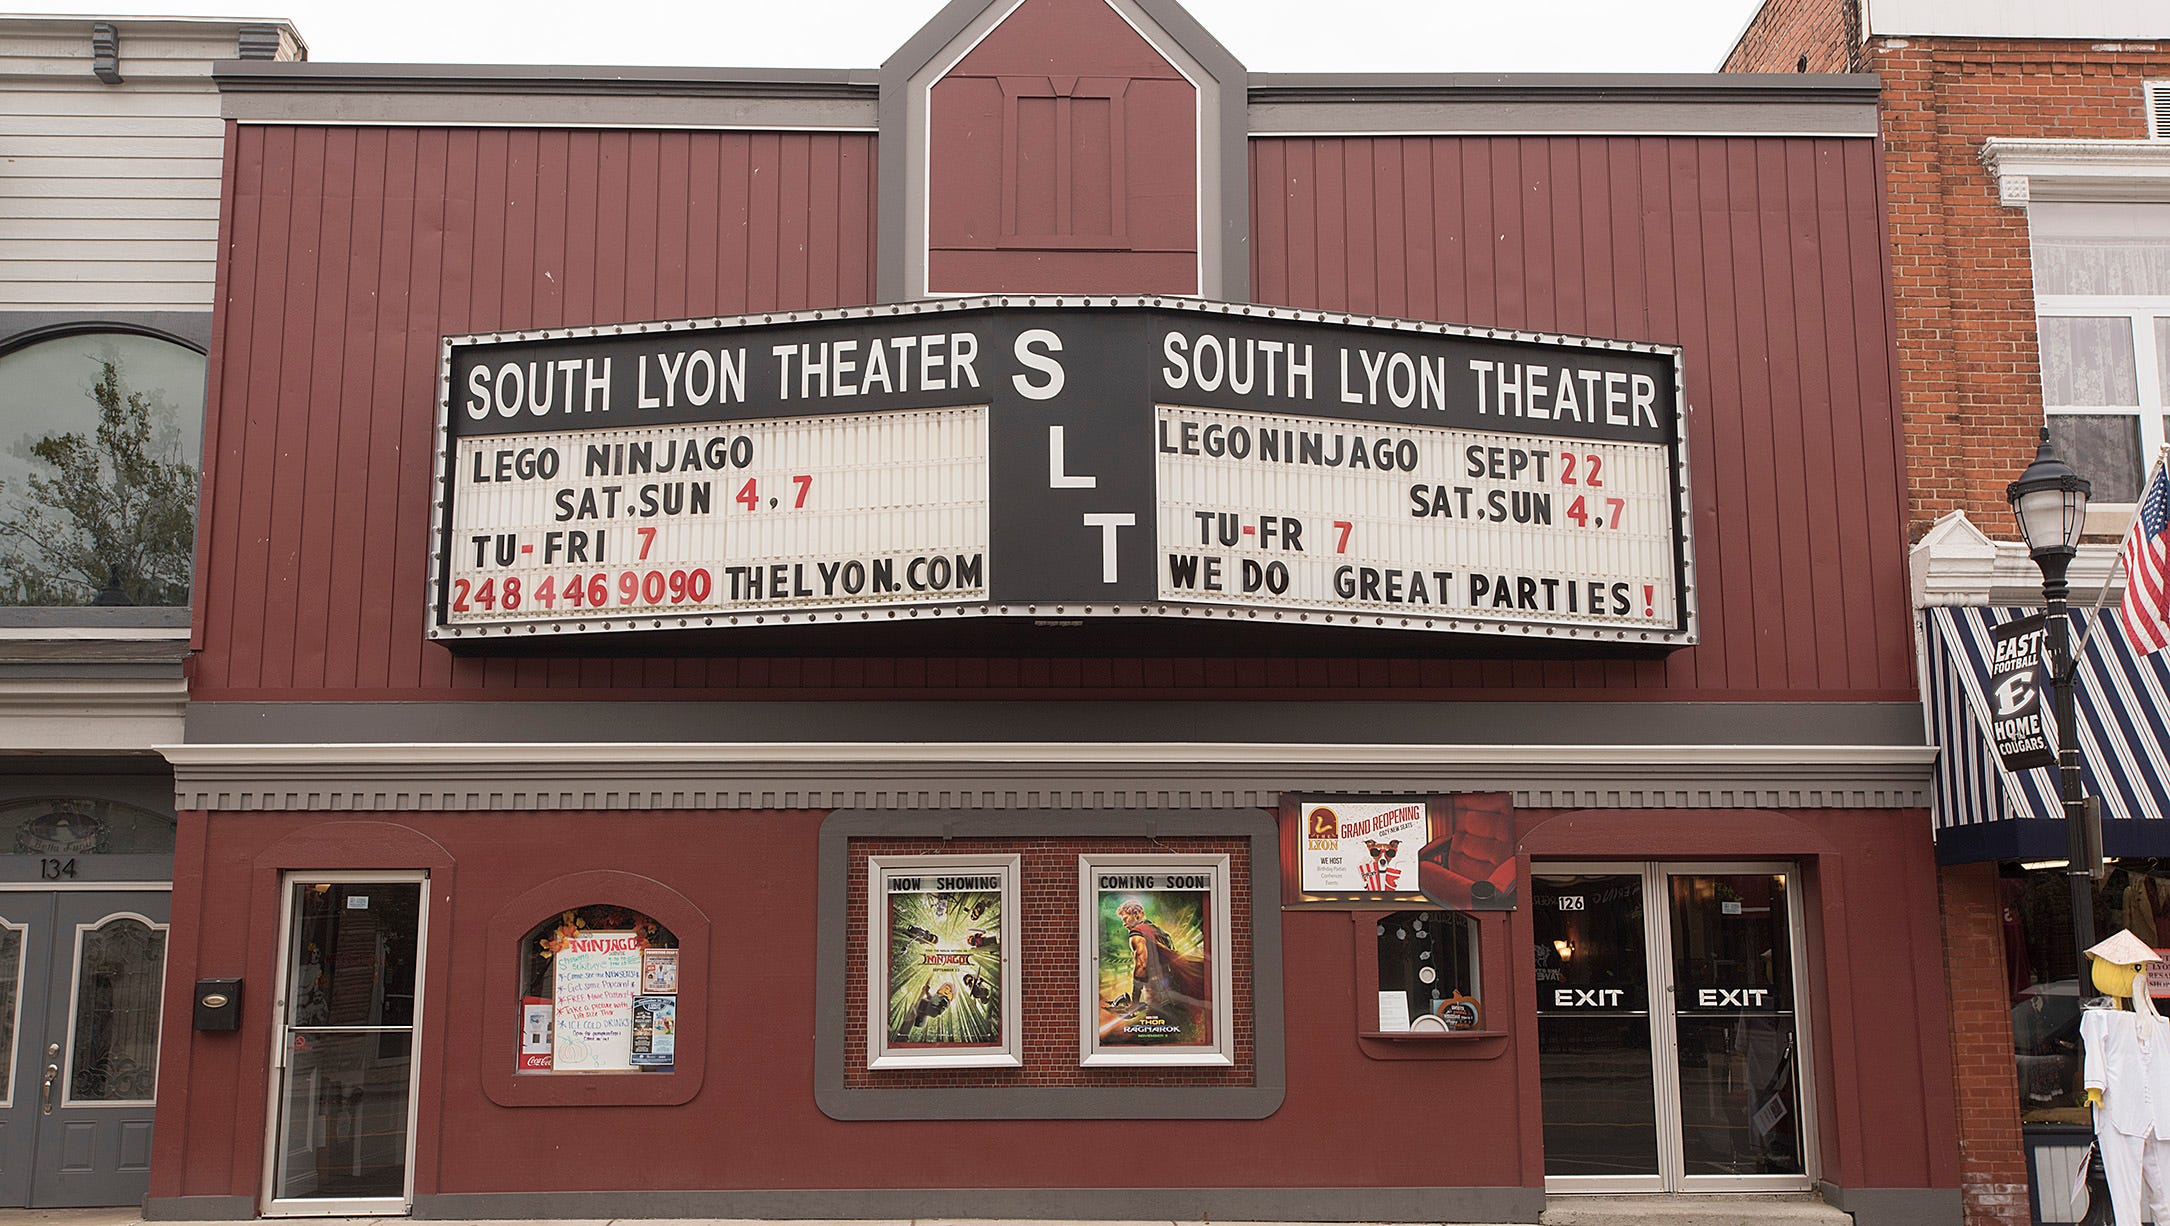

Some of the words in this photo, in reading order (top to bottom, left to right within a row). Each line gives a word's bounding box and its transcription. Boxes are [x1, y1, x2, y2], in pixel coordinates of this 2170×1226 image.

[466, 357, 612, 421] SOUTH
[638, 348, 747, 409] LYON
[772, 331, 980, 401] THEATER
[1162, 331, 1314, 400] SOUTH
[1340, 347, 1445, 411] LYON
[1469, 359, 1659, 429] THEATER
[473, 446, 560, 484] LEGO
[585, 435, 754, 477] NINJAGO
[1160, 419, 1251, 459] LEGO
[1260, 428, 1418, 471] NINJAGO
[1467, 444, 1549, 483] SEPT
[1560, 452, 1604, 487] 22
[637, 527, 657, 561] 7
[1333, 520, 1353, 555] 7
[454, 576, 522, 614] 248
[534, 571, 608, 609] 446
[619, 567, 713, 606] 9090
[725, 553, 983, 601] THELYON.COM
[1169, 555, 1223, 591] WE
[1242, 559, 1290, 595] DO
[1333, 564, 1453, 605] GREAT
[1996, 629, 2043, 663] EAST
[1994, 654, 2038, 675] FOOTBALL
[1995, 671, 2035, 715] E
[1994, 714, 2040, 741] HOME
[1341, 819, 1371, 839] GRAND
[1373, 805, 1420, 832] REOPENING
[1379, 829, 1390, 837] COZY
[1390, 825, 1400, 834] NEW
[1400, 822, 1413, 831] SEATS
[1308, 840, 1338, 851] LYON
[41, 858, 77, 880] 134
[1320, 857, 1329, 865] WE
[1329, 857, 1342, 865] HOST
[893, 878, 920, 891] NOW
[937, 877, 998, 890] SHOWING
[1100, 875, 1155, 890] COMING
[1166, 875, 1205, 889] SOON
[1560, 897, 1583, 910] 126
[570, 938, 638, 955] NINJAGO
[926, 955, 967, 966] NINJAGO
[1555, 989, 1624, 1006] EXIT
[1699, 989, 1768, 1006] EXIT
